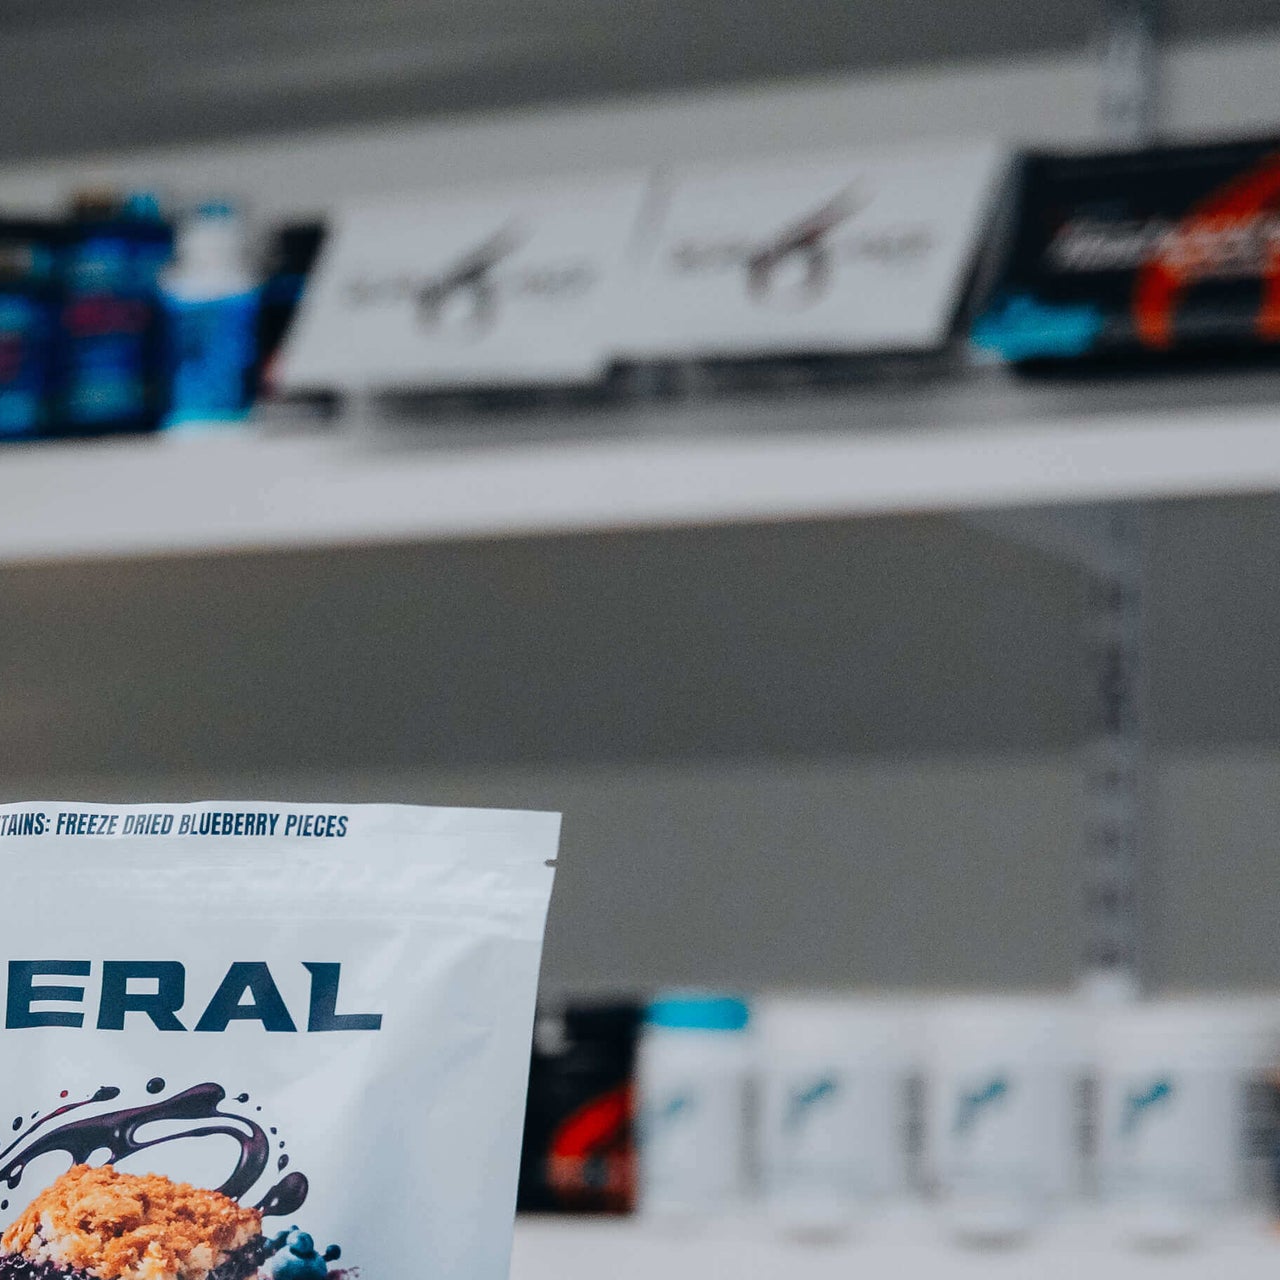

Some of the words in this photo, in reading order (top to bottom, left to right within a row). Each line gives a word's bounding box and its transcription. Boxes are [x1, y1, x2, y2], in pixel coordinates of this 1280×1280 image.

[55, 812, 119, 836] FREEZE
[122, 812, 175, 836] DRIED
[178, 812, 280, 837] BLUEBERRY
[285, 814, 349, 838] PIECES
